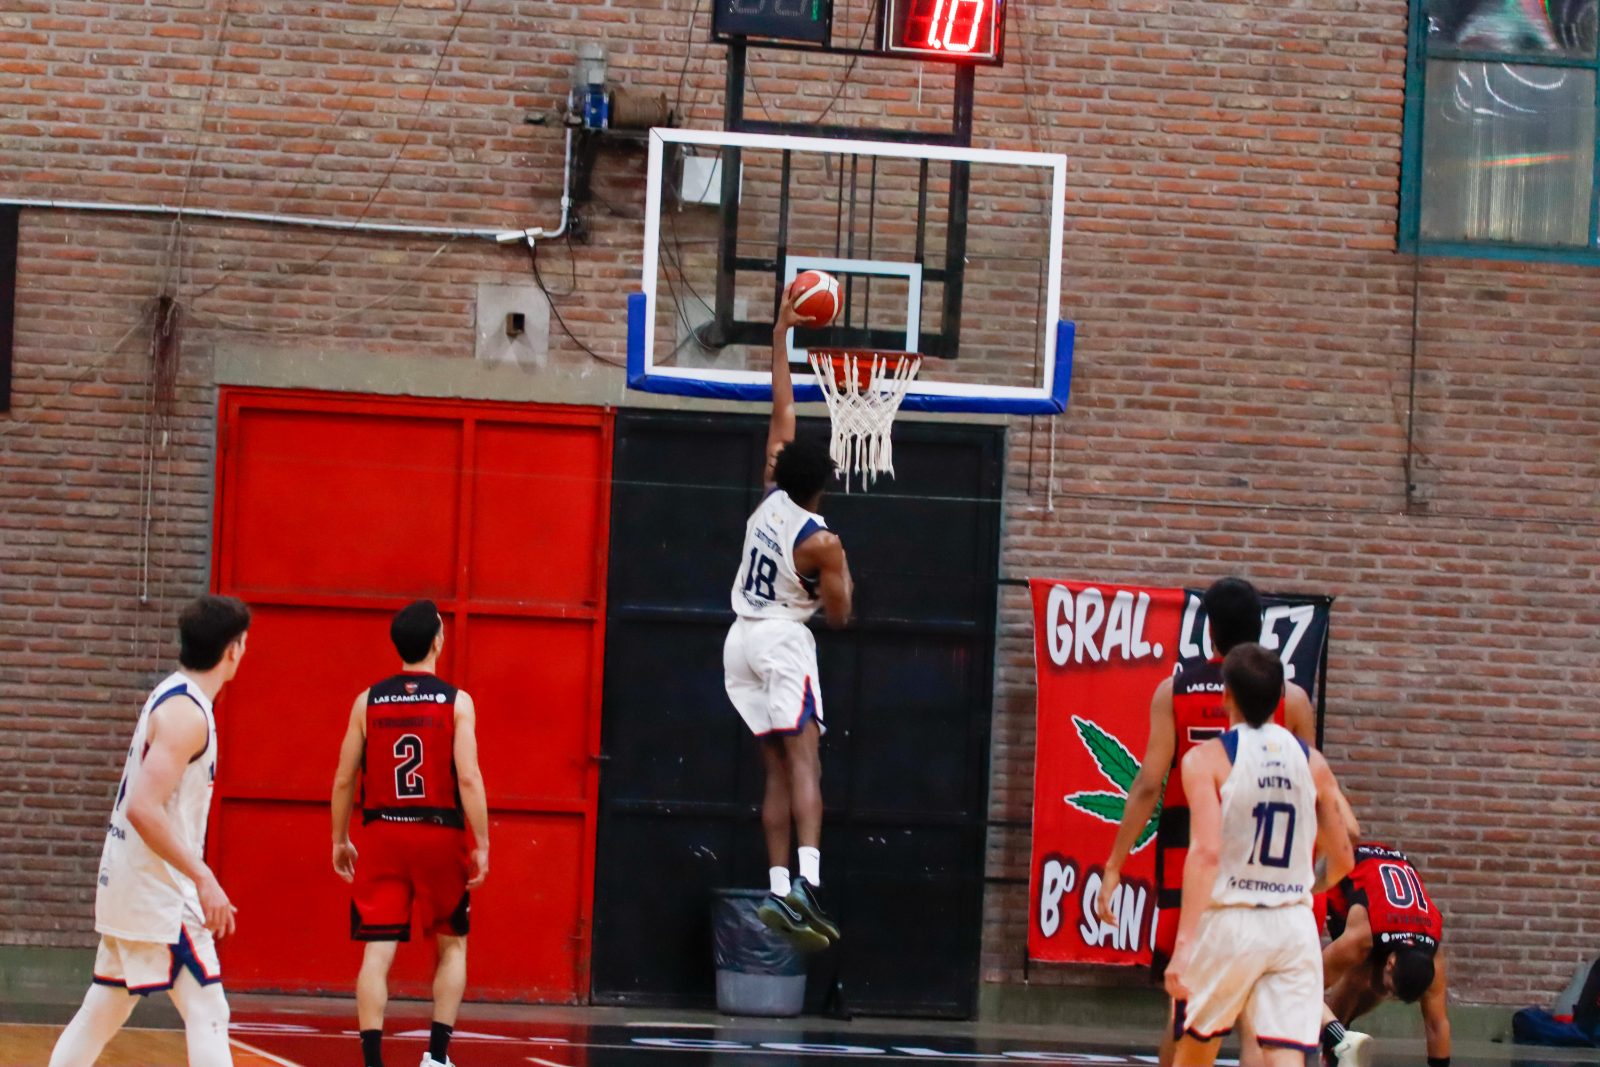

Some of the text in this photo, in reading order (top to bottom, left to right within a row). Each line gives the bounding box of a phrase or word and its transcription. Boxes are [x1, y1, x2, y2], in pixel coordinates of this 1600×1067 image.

[745, 546, 778, 601] 18
[1046, 584, 1163, 666] GRAL.
[374, 693, 435, 704] LAS CAMELIAS
[1187, 683, 1205, 693] LAS
[393, 733, 426, 800] 2
[1247, 801, 1296, 869] 10
[1080, 872, 1147, 952] SAN
[1237, 878, 1304, 894] CETROGAR
